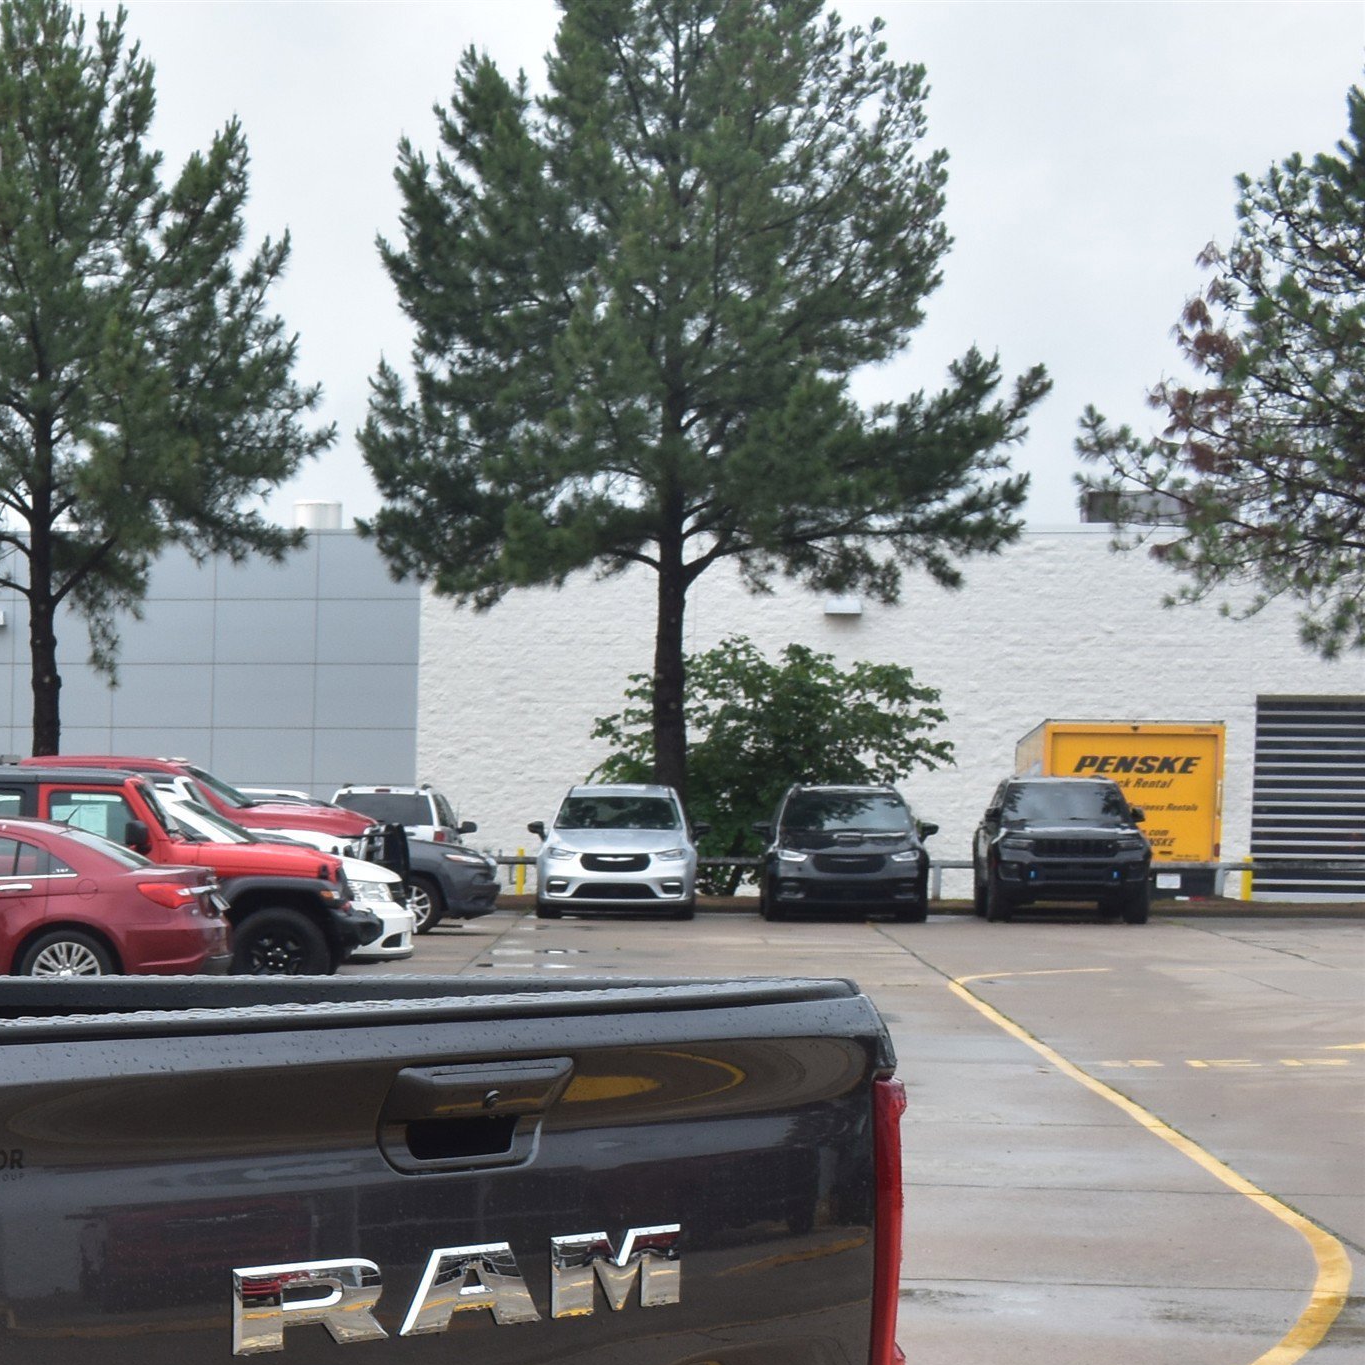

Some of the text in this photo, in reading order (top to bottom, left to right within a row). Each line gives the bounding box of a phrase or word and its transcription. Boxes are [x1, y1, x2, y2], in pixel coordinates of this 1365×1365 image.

[1073, 755, 1201, 774] PENSKE
[1133, 778, 1174, 789] Rental
[233, 1224, 680, 1356] RAM
